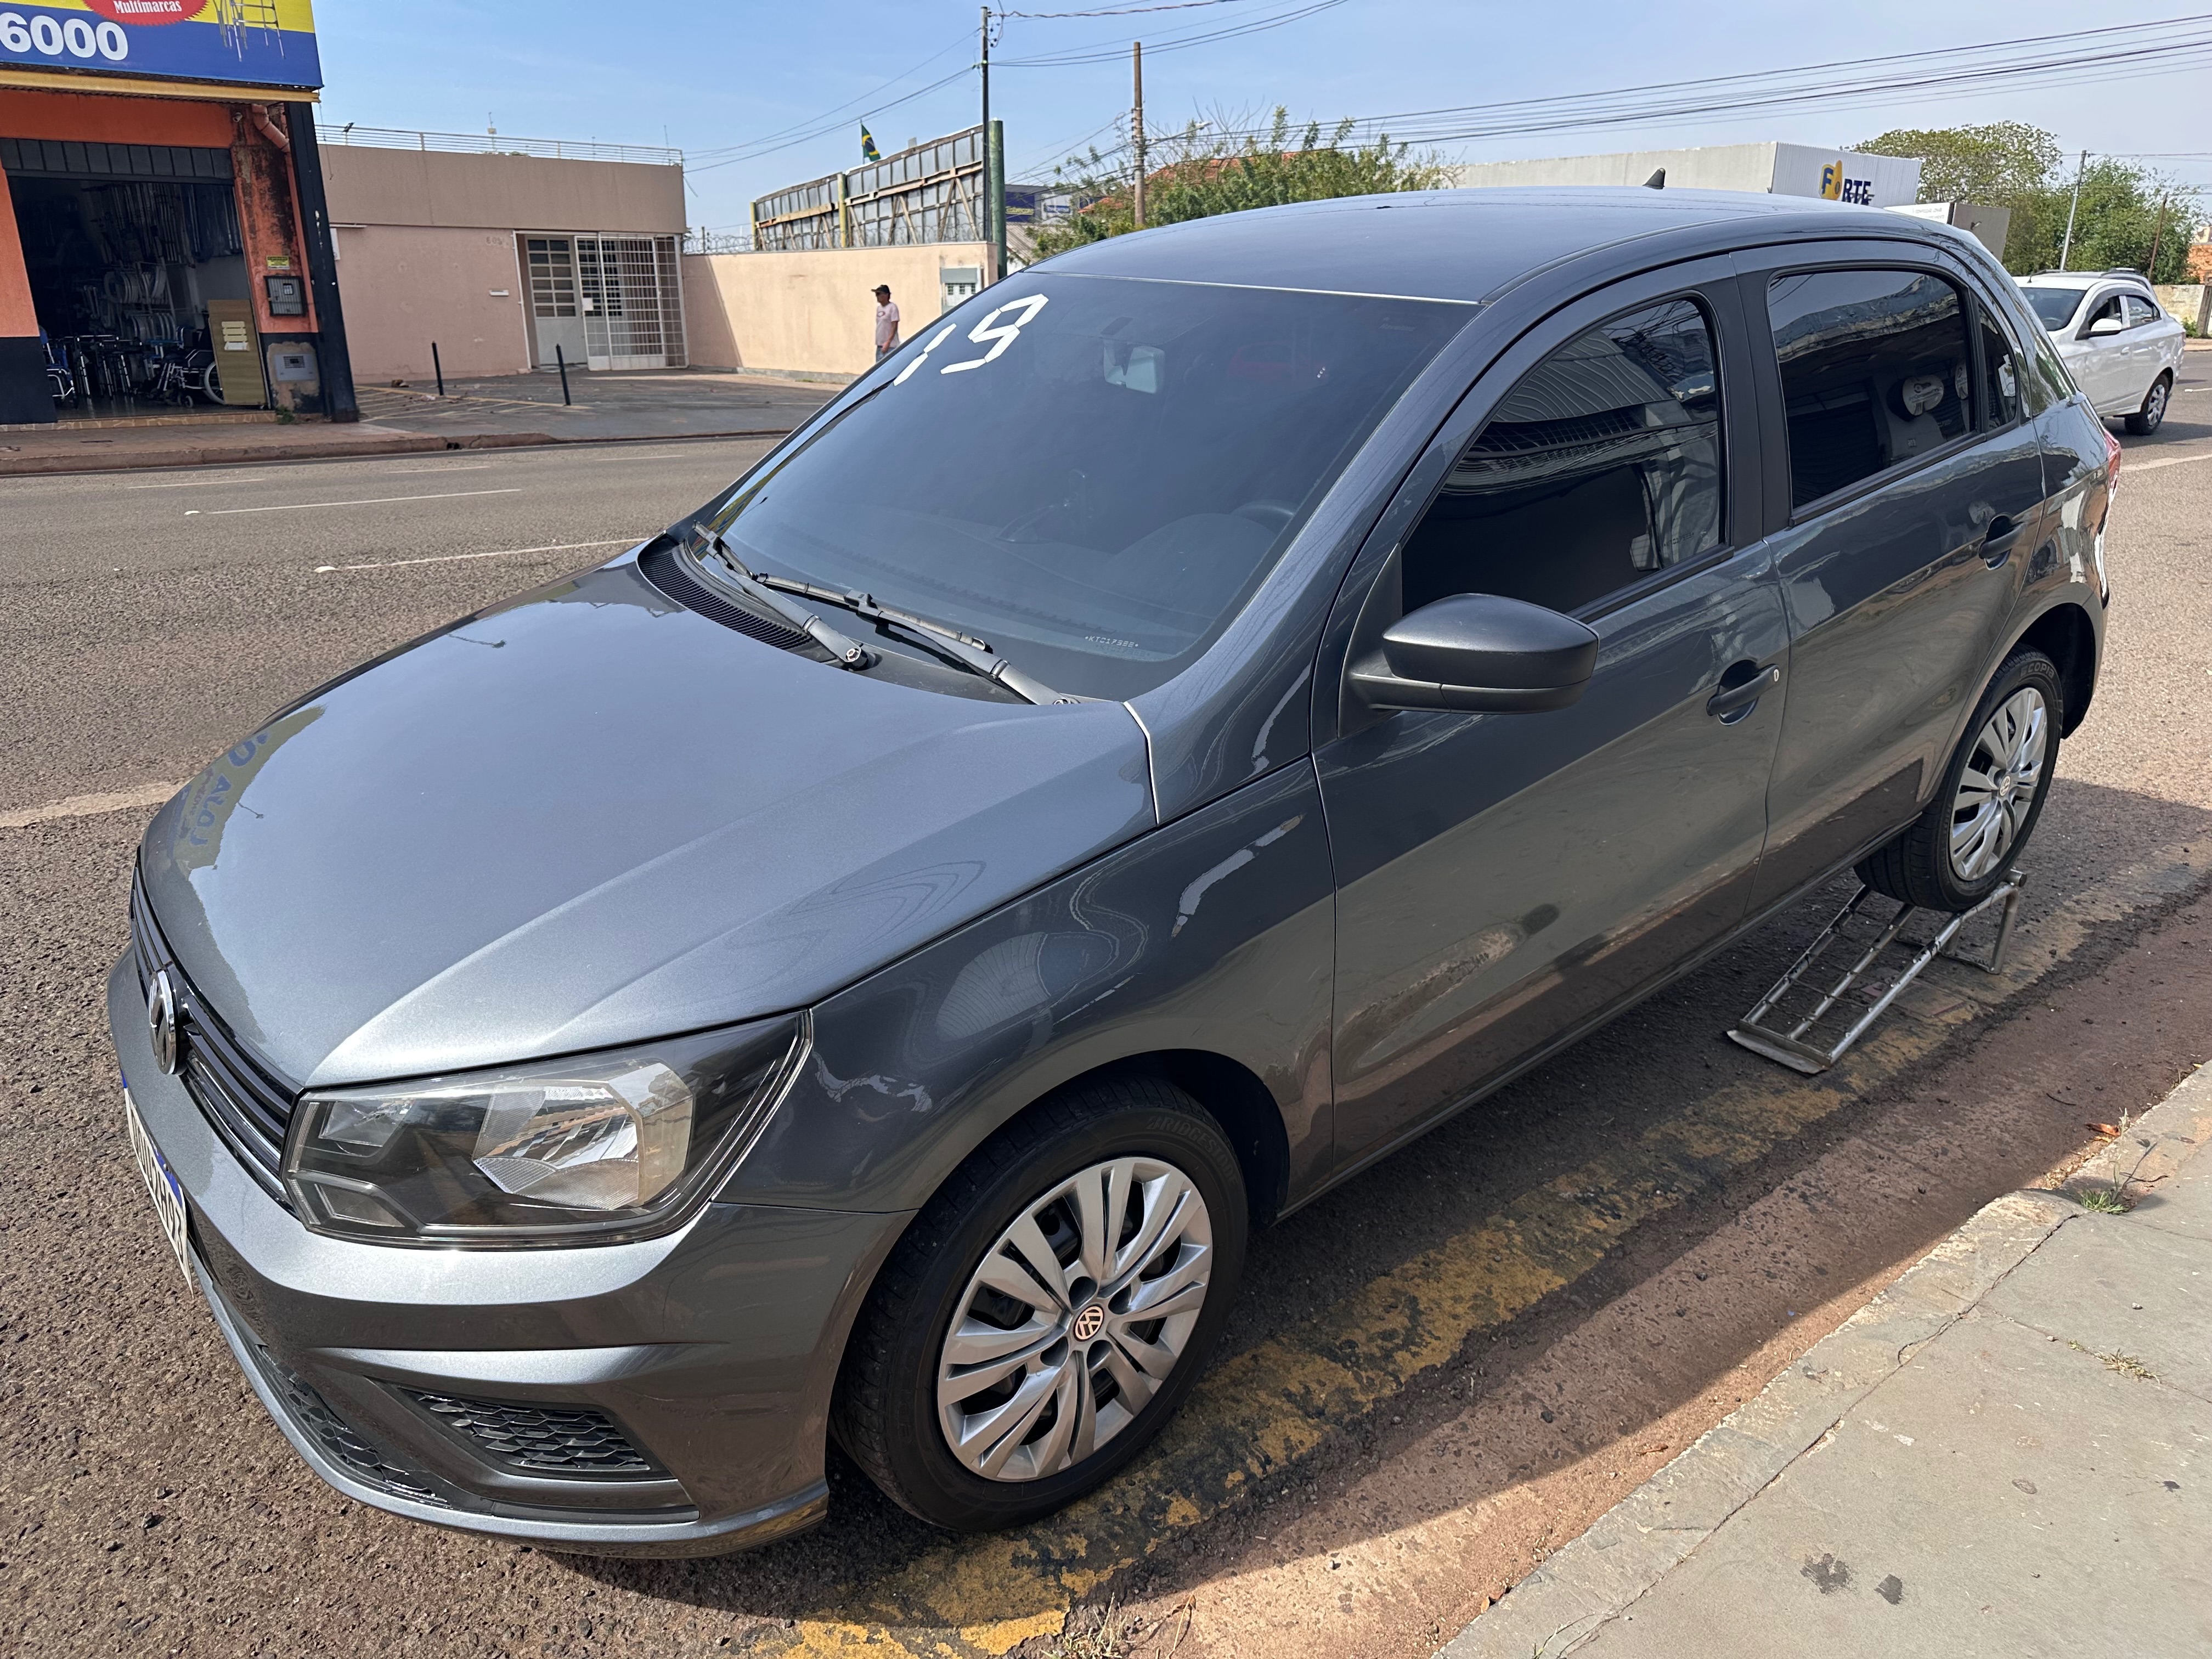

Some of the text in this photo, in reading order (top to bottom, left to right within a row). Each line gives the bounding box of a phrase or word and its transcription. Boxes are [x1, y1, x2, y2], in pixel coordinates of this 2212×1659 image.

[113, 0, 183, 14] Multimarcas
[0, 12, 128, 60] 6000
[1821, 167, 1871, 206] FORTE
[893, 293, 1049, 386] 19
